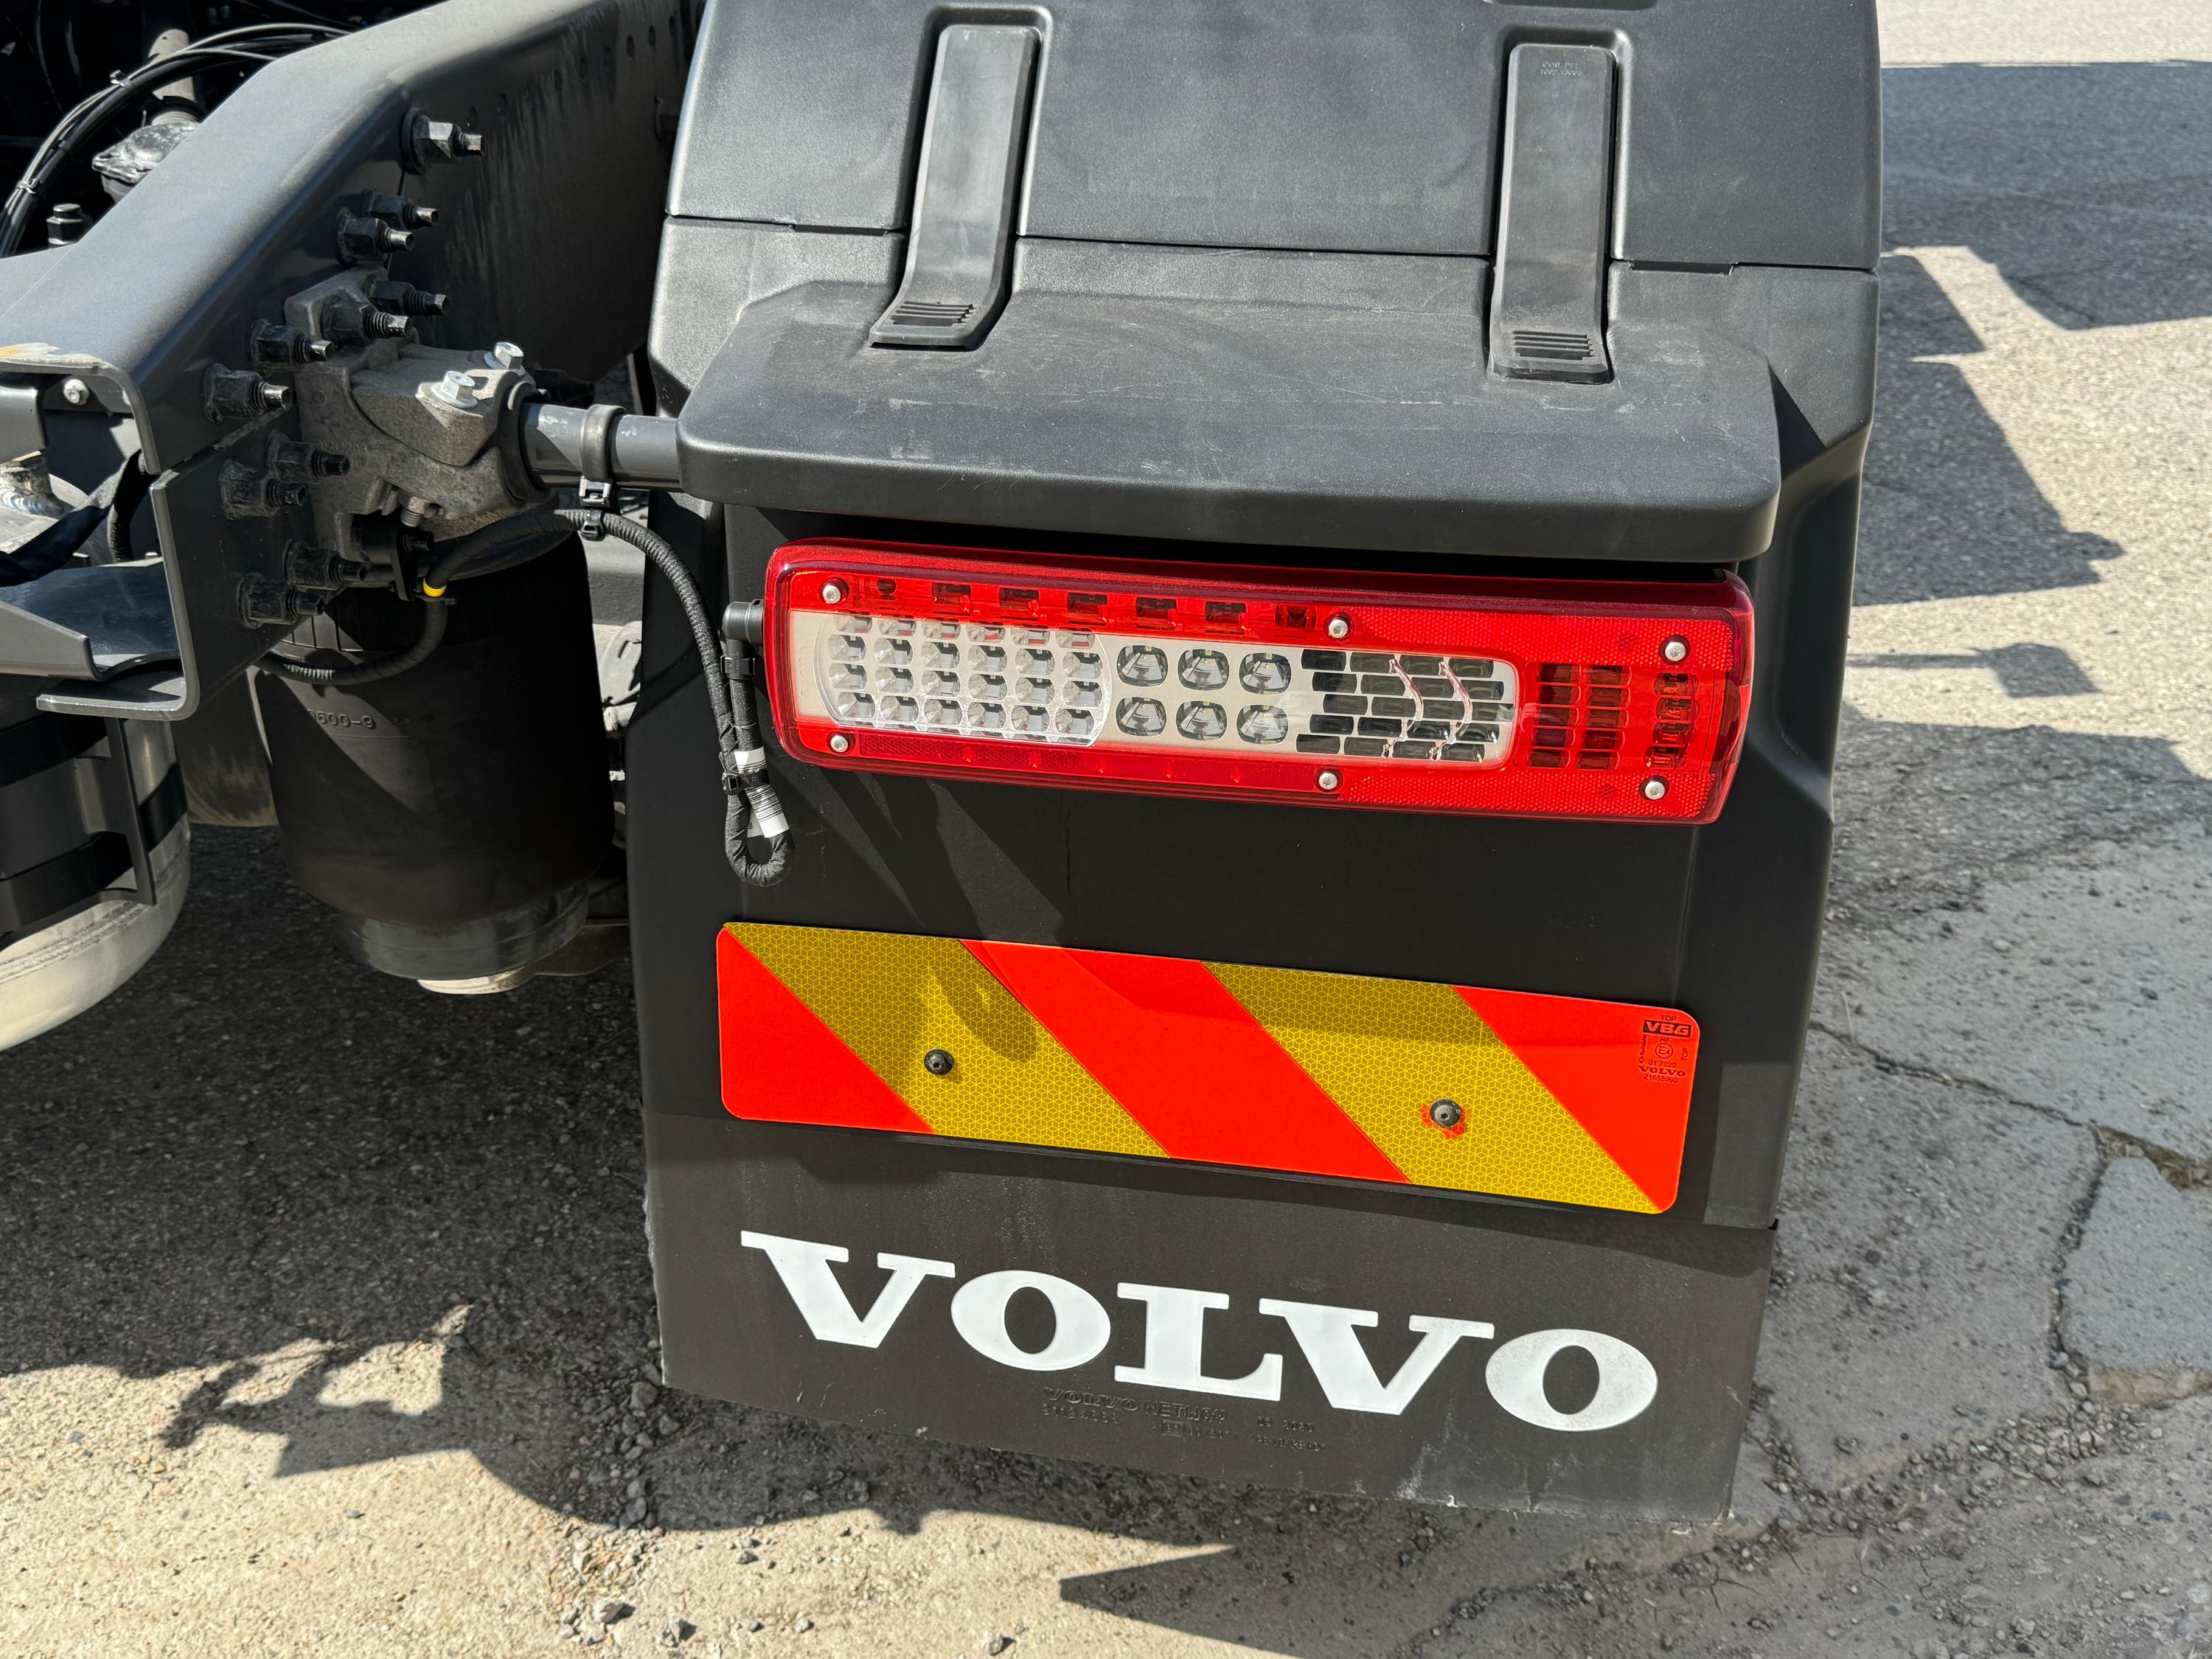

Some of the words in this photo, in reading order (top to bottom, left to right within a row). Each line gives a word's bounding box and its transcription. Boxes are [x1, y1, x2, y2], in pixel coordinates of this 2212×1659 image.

[1646, 1022, 1689, 1036] VBG
[1638, 1065, 1686, 1077] VOLVO
[741, 1231, 1658, 1432] VOLVO
[1044, 1387, 1139, 1411] VOLVO
